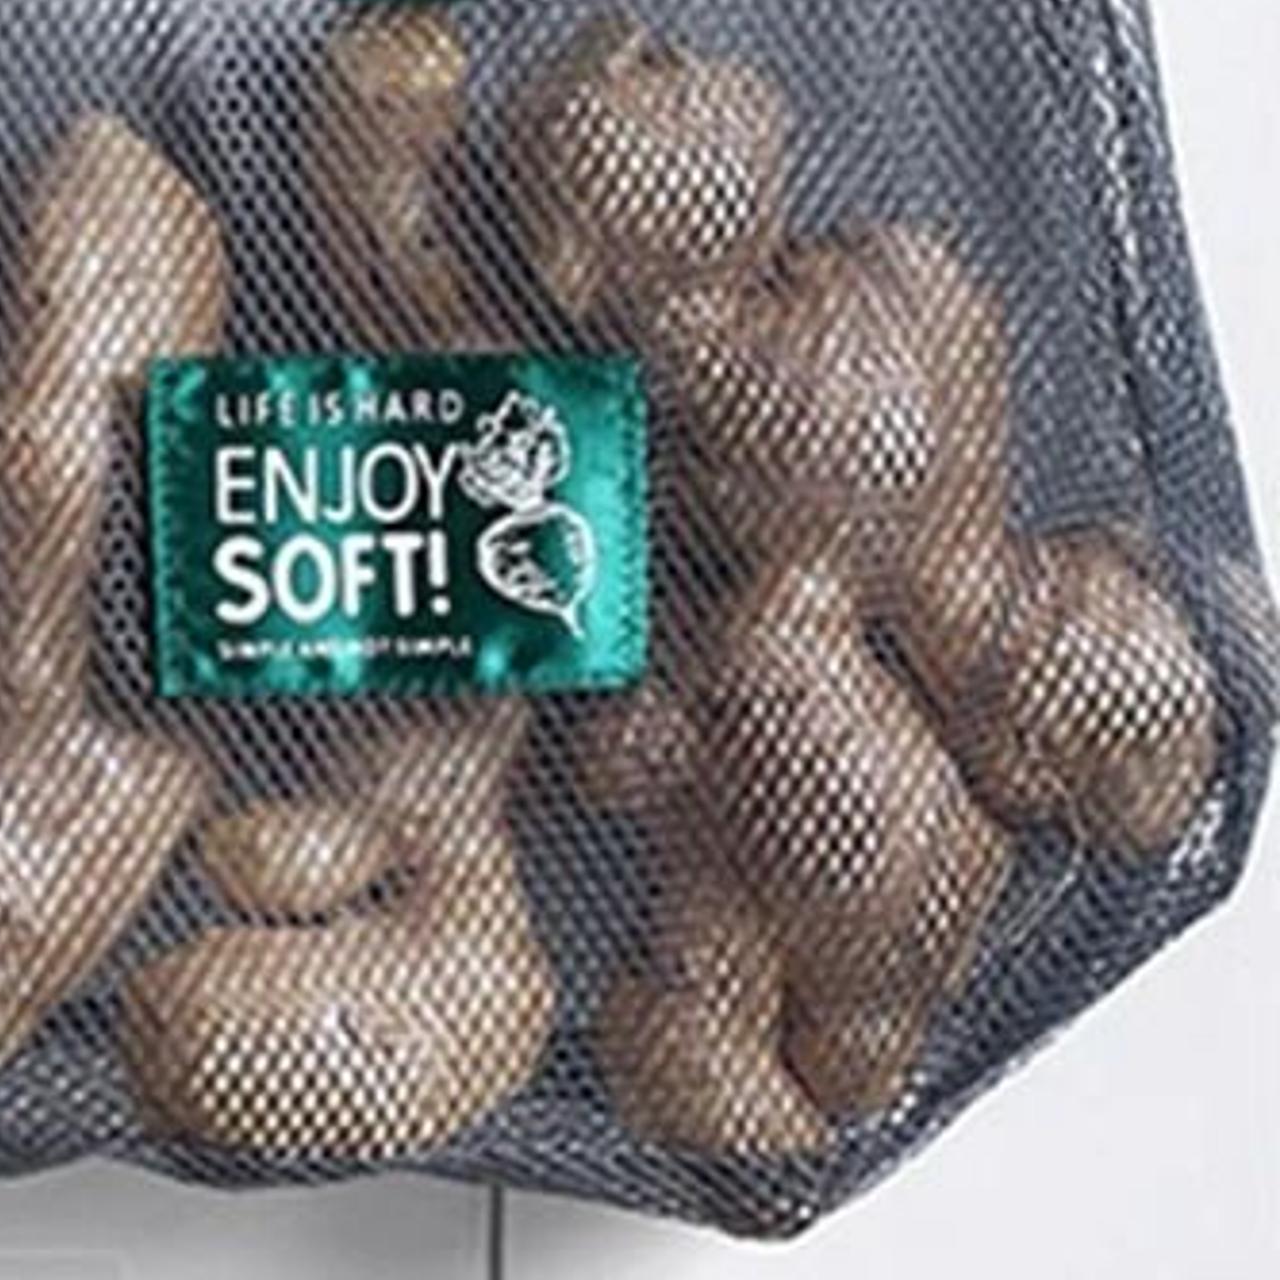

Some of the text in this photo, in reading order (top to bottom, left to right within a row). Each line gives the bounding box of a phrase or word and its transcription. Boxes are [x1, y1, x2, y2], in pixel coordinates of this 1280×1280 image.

[216, 390, 465, 427] LIFE IS HARD
[215, 442, 457, 523] ENJOY
[213, 531, 450, 623] SOFT!
